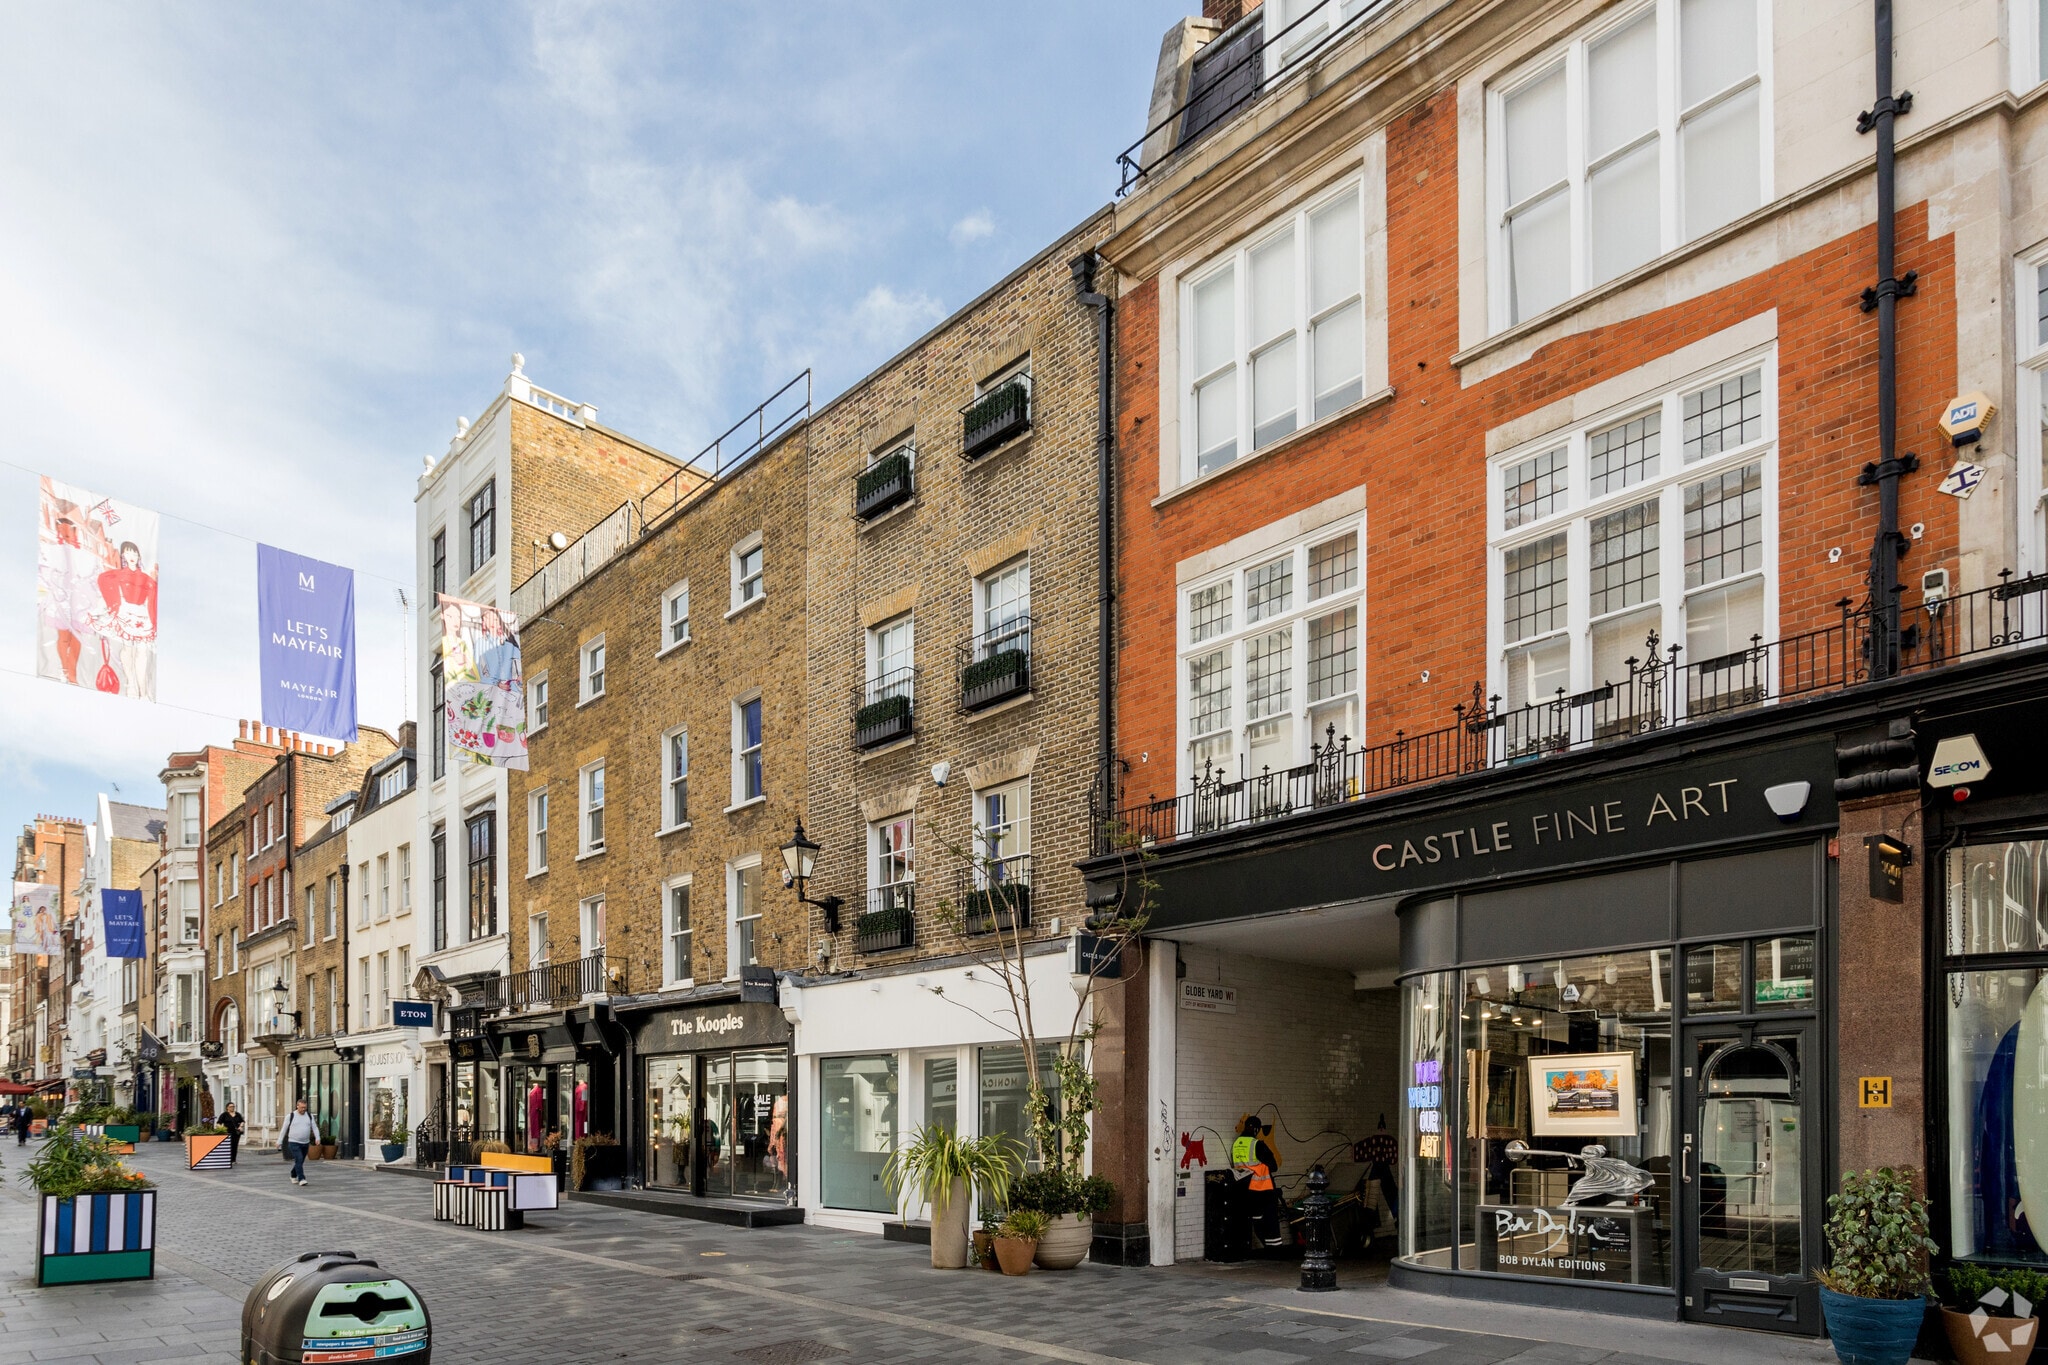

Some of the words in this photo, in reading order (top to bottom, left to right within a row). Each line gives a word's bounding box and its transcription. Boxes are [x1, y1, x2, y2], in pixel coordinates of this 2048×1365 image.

[1951, 405, 1977, 422] ADT
[299, 572, 315, 590] M
[287, 619, 329, 640] LET'S
[272, 632, 343, 659] MAYFAIR
[280, 679, 338, 699] MAYFAIR
[297, 693, 323, 702] LONDON
[1934, 760, 1980, 776] SECOM
[1372, 821, 1512, 871] CASTLE
[1532, 800, 1626, 845] FINE
[1646, 779, 1738, 826] ART
[1082, 951, 1098, 960] CASTE
[1185, 985, 1206, 998] GLOBE
[1207, 988, 1224, 1000] YARD
[1225, 991, 1234, 1001] W1
[400, 1010, 427, 1019] ETON
[671, 1018, 693, 1036] The
[695, 1013, 744, 1035] Kooples
[141, 1047, 158, 1058] 48
[1415, 1061, 1440, 1084] YOUR
[753, 1094, 771, 1104] SALE
[1408, 1086, 1440, 1108] WORLD
[1420, 1111, 1439, 1132] OUR
[1420, 1135, 1438, 1157] ART
[1499, 1255, 1518, 1265] BOB
[1522, 1256, 1555, 1268] DYLAN
[1558, 1259, 1606, 1272] EDITIONS
